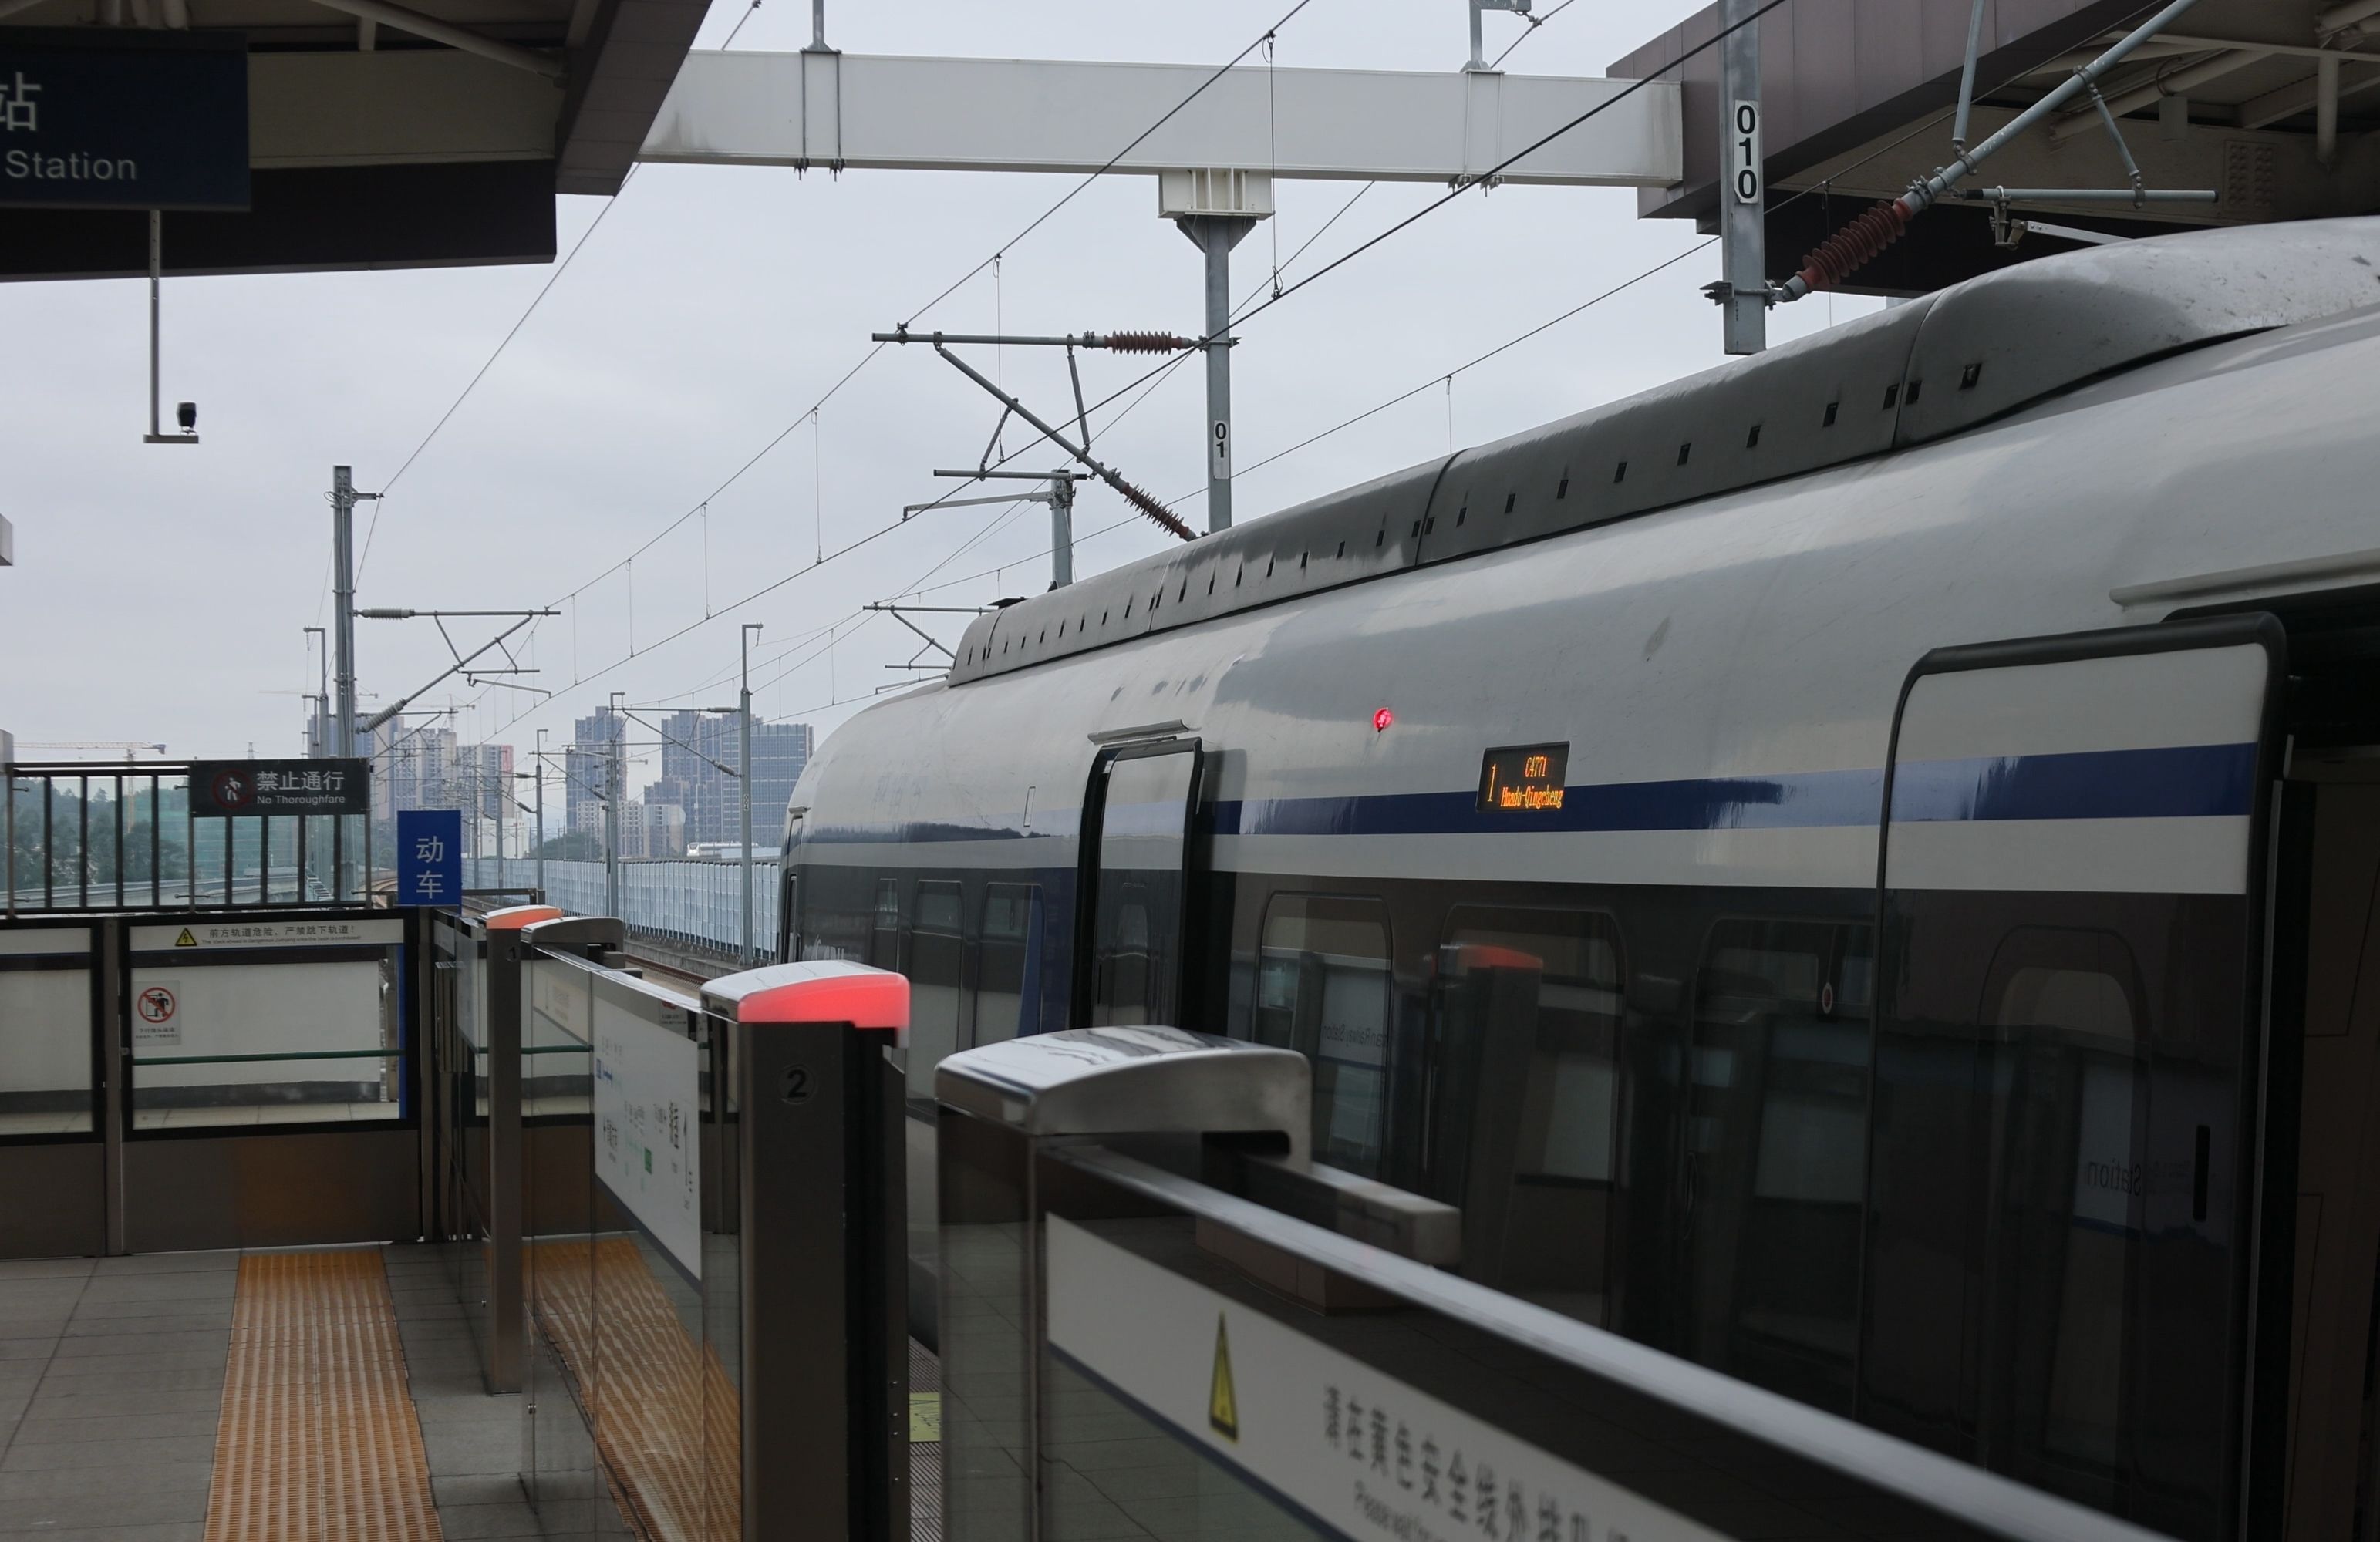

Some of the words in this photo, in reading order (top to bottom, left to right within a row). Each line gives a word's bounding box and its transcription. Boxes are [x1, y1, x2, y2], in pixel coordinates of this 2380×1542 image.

[5, 150, 137, 180] Station
[1737, 105, 1757, 199] 010
[257, 771, 345, 791] 禁止通行
[1525, 756, 1548, 778] C4771
[1487, 763, 1497, 802] 1
[257, 796, 272, 804] No
[275, 794, 346, 806] Thoroughfare
[416, 835, 444, 900] 动车
[787, 1069, 807, 1098] 2
